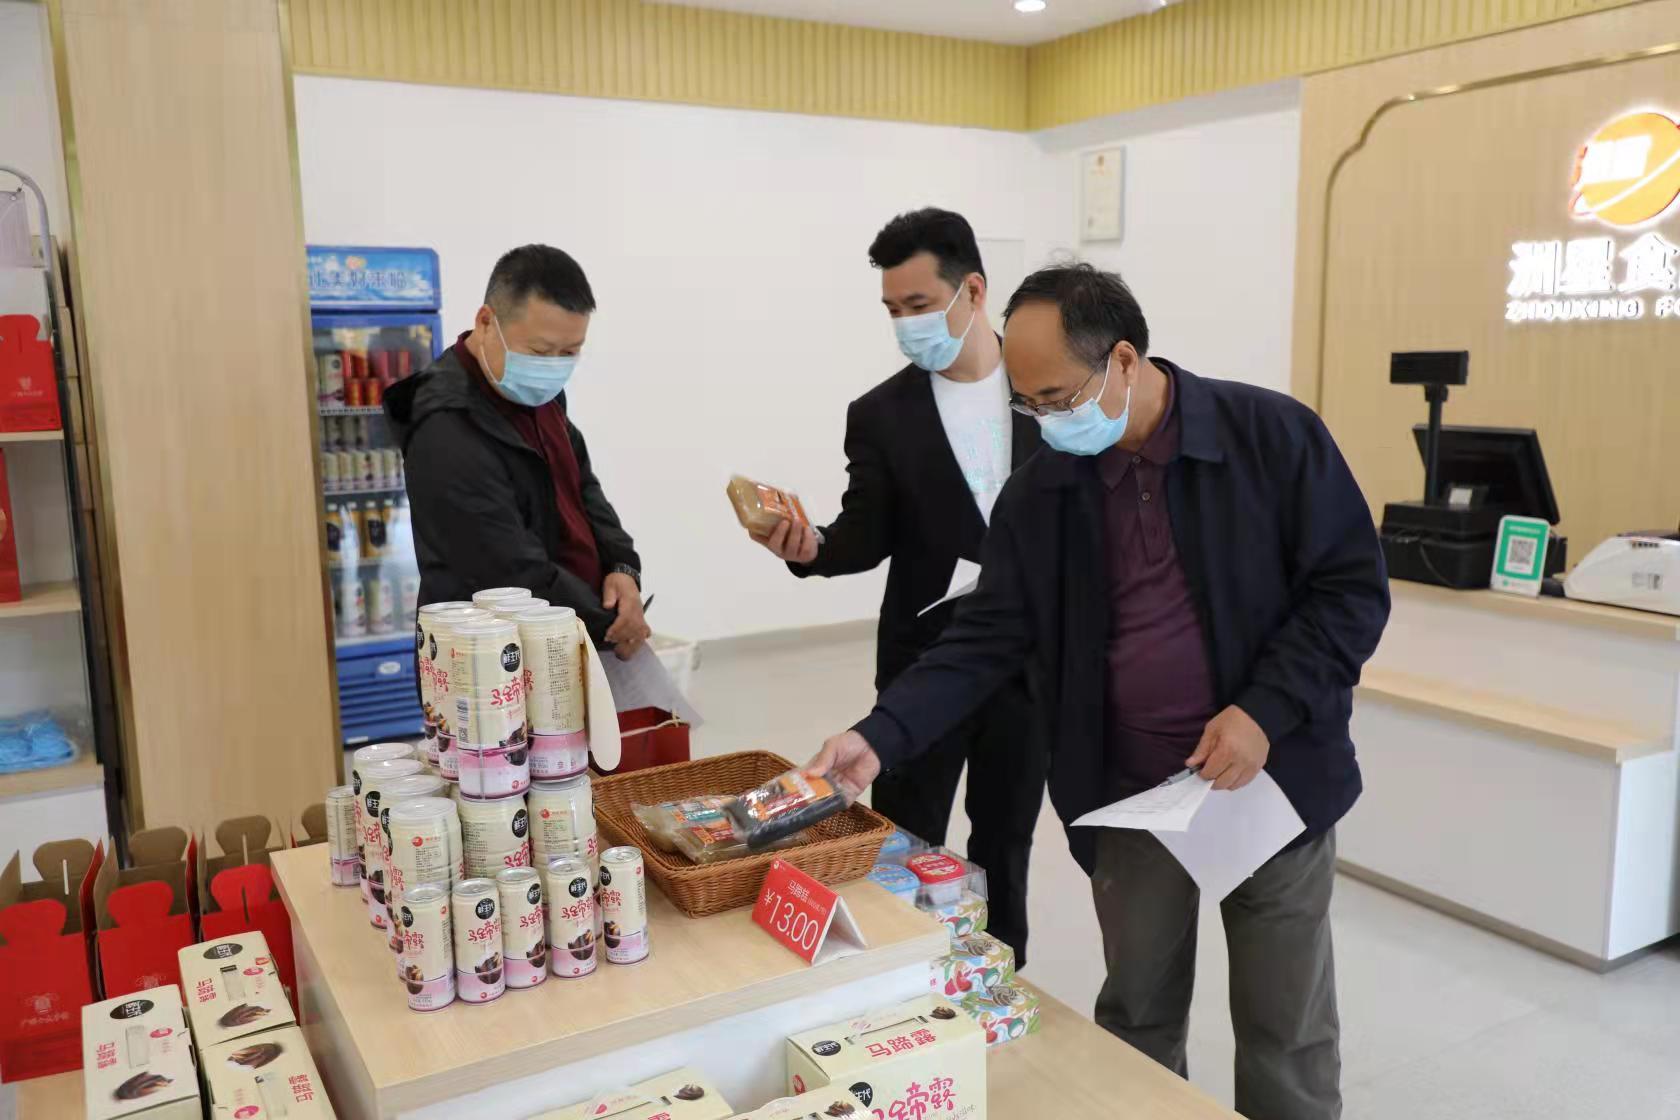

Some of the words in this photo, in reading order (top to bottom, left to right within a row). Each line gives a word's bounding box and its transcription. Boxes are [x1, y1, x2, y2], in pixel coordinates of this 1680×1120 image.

[490, 675, 524, 705] 马蹄
[764, 888, 819, 951] ¥13.00
[865, 1029, 936, 1057] 马蹄露
